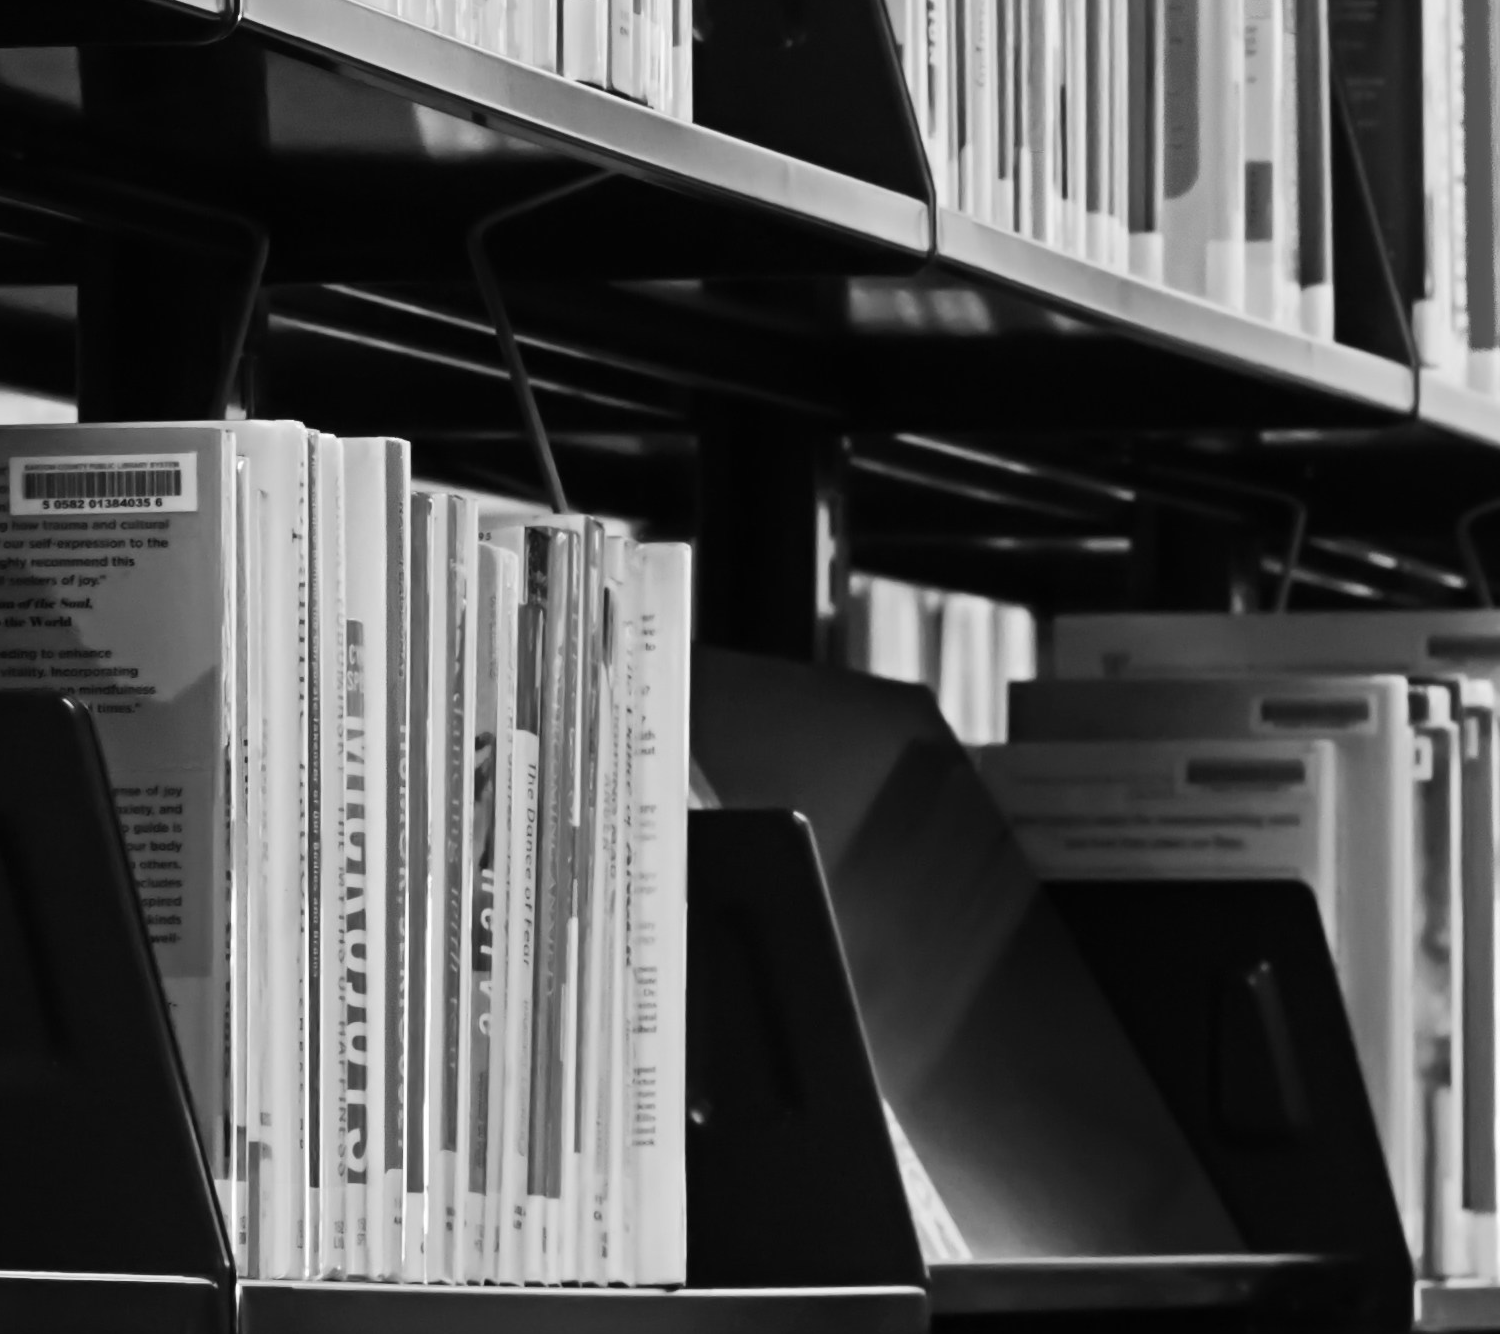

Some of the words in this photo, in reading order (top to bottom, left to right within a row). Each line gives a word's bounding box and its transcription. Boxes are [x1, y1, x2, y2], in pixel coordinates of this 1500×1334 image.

[54, 499, 85, 509] 0582
[130, 537, 144, 551] to
[147, 537, 169, 551] the
[112, 557, 136, 569] this
[41, 649, 55, 661] to
[163, 786, 183, 799] joy
[149, 841, 183, 853] body
[525, 807, 537, 880] Dance
[523, 886, 536, 911] of
